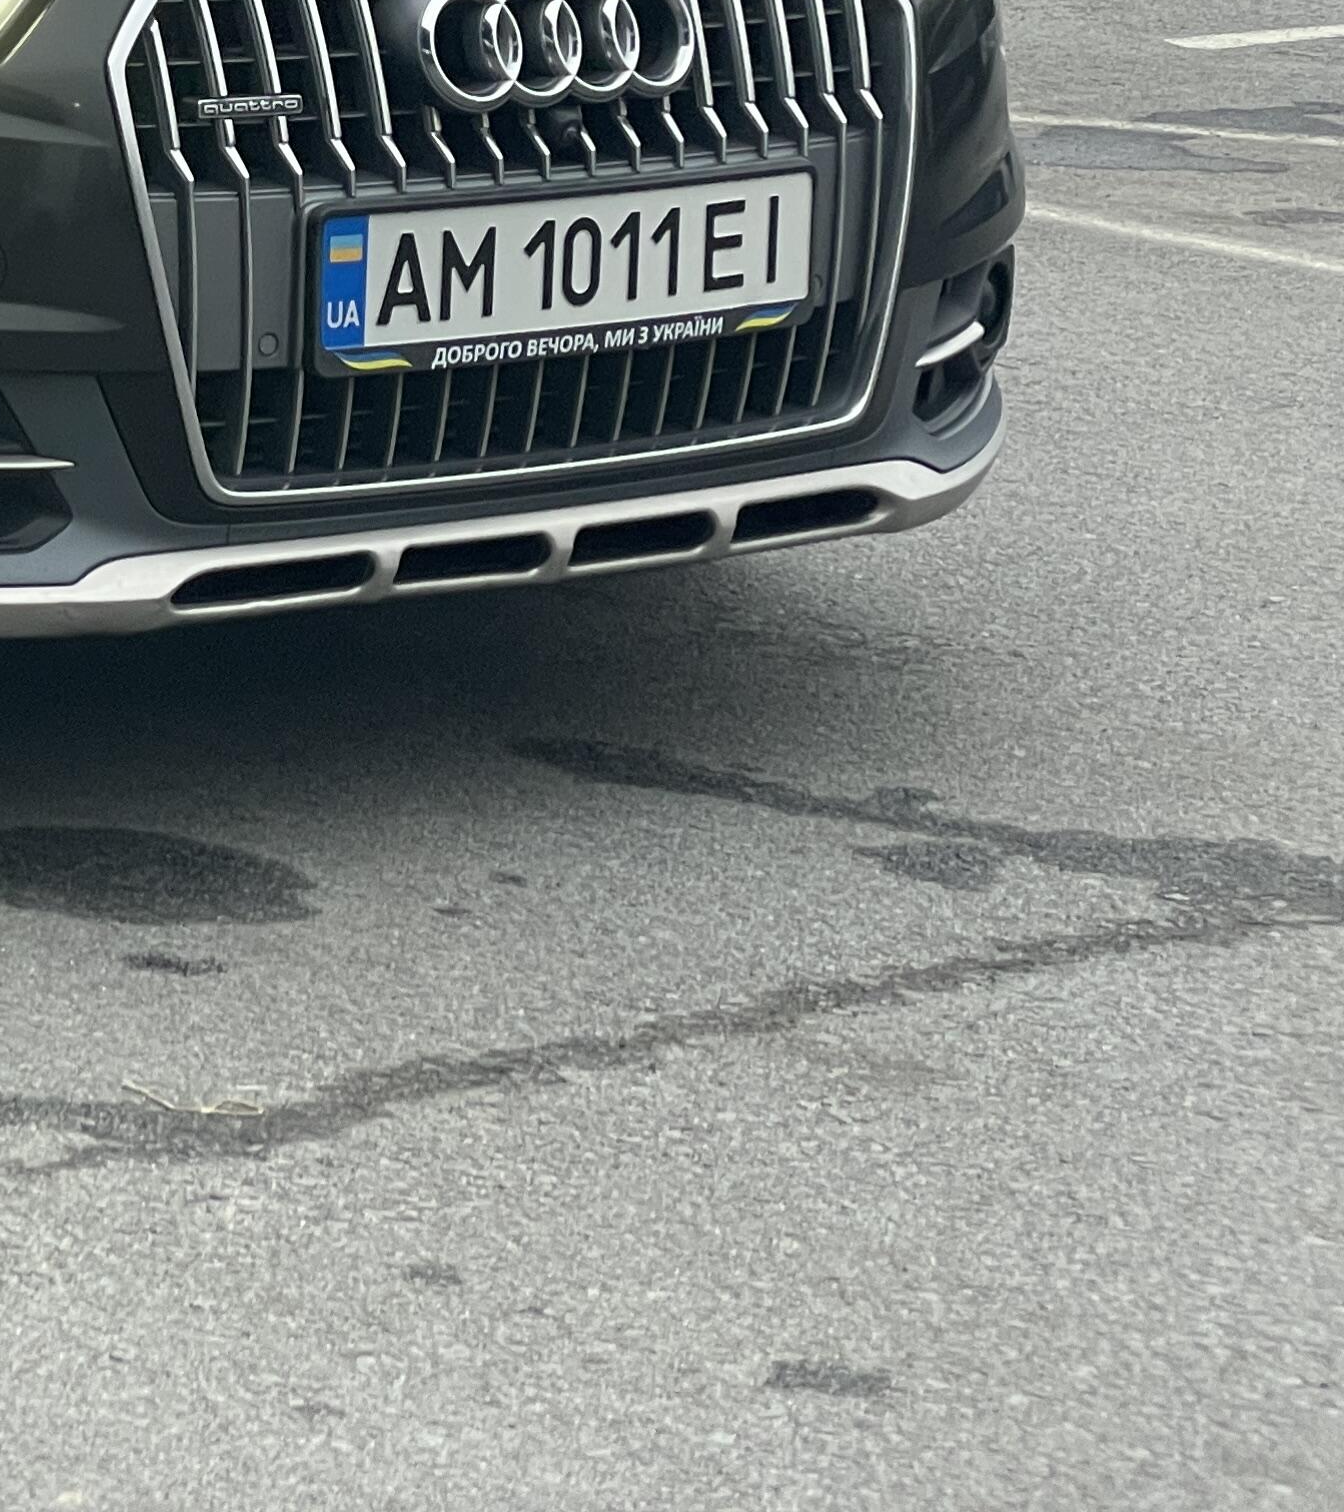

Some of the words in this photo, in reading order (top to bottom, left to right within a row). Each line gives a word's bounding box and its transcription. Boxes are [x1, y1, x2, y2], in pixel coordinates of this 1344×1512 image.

[203, 99, 299, 115] quattro
[375, 226, 497, 326] AM
[524, 207, 681, 310] 1011
[704, 195, 780, 293] EI
[326, 300, 361, 329] UA
[431, 339, 523, 370] ДОБРОГО
[526, 332, 600, 359] ВЕЧОРА,
[604, 327, 636, 349] МИ
[638, 326, 650, 345] З
[652, 315, 724, 344] УКРАЇНИ
